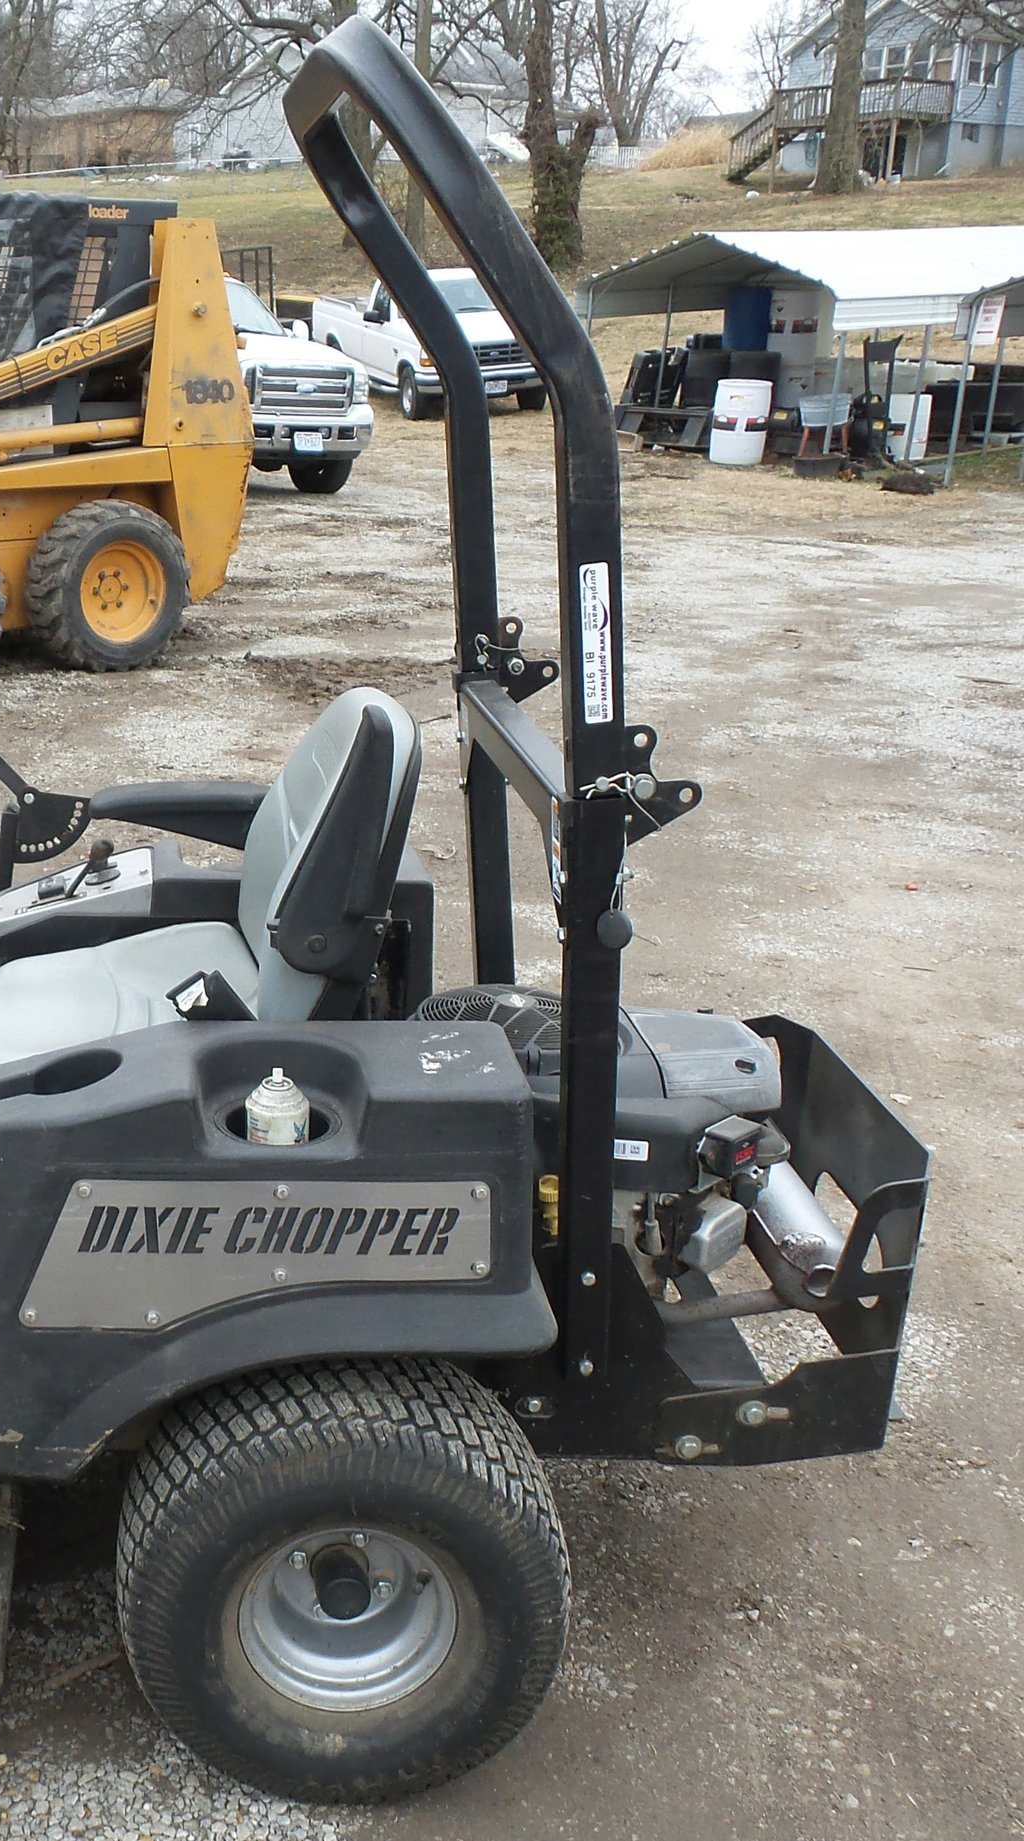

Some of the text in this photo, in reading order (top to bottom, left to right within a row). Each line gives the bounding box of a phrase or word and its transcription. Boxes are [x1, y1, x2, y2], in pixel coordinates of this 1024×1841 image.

[88, 203, 130, 220] loader
[46, 326, 118, 371] CASE
[184, 377, 235, 404] 1840
[589, 569, 599, 601] purple
[586, 672, 596, 698] 9175
[598, 631, 609, 720] www.purplewave.com
[77, 1205, 461, 1256] DIXIE CHOPPER
